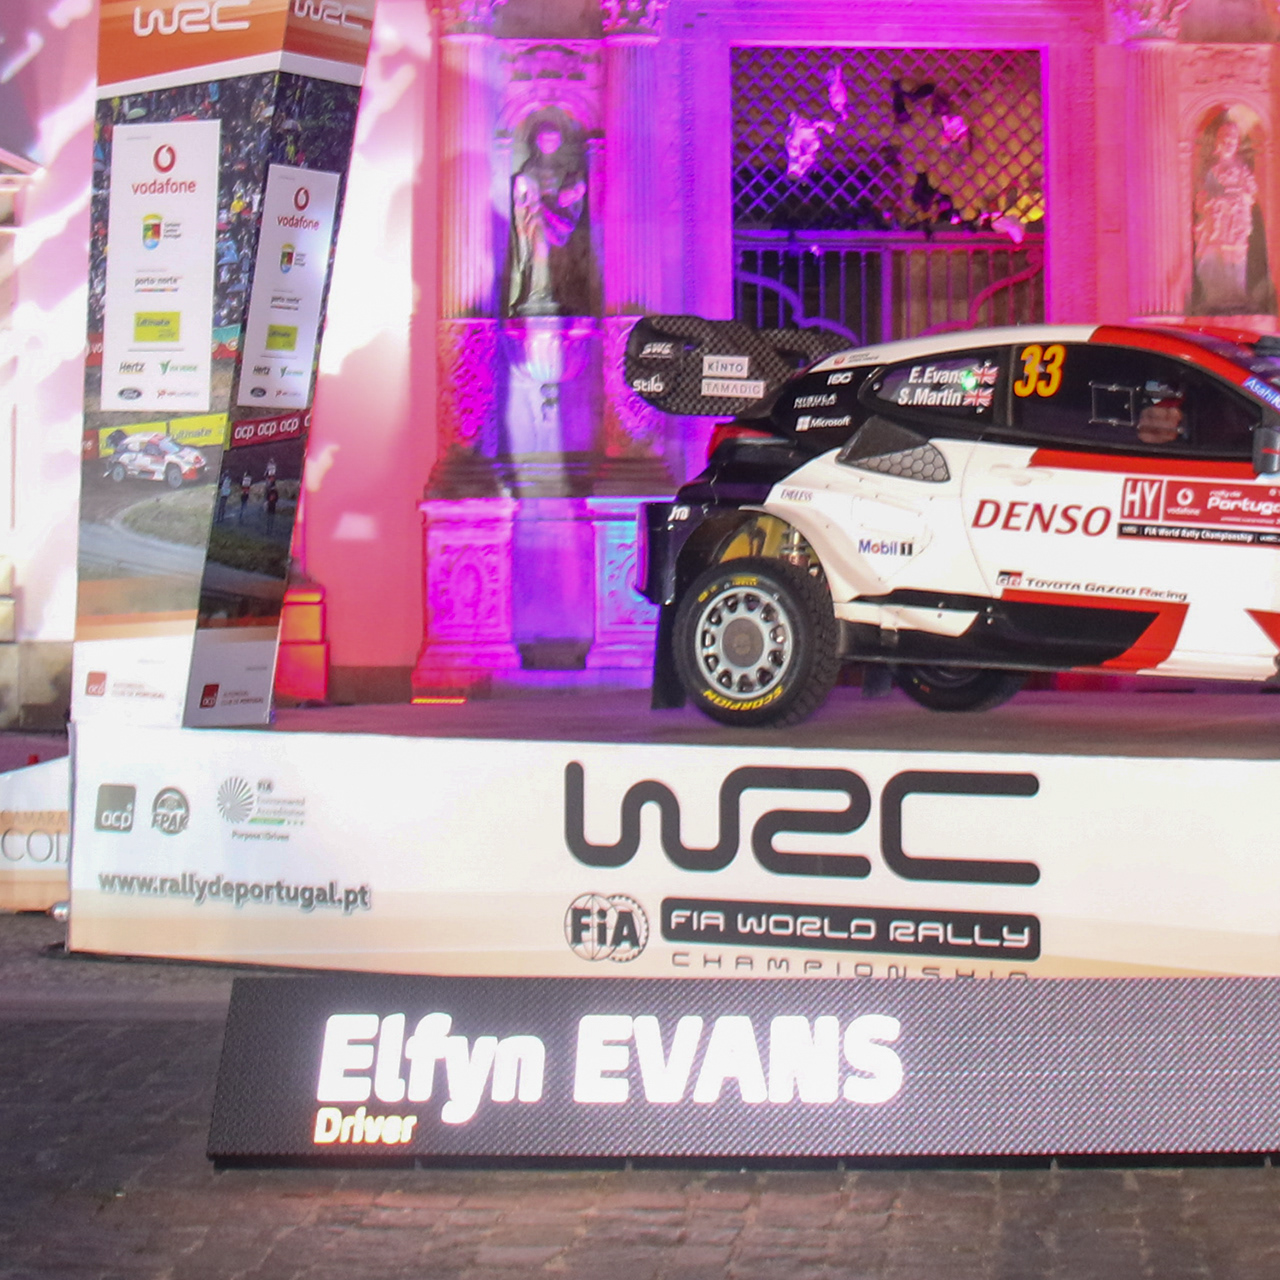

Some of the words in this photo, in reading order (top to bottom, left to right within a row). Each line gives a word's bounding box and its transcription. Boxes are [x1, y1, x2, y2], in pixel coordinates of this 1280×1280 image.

[131, 178, 197, 195] vodafone
[277, 215, 320, 231] vodafone
[908, 366, 966, 384] E.Evans
[1013, 344, 1067, 398] 33
[632, 374, 664, 393] Stilo
[704, 382, 761, 395] TAMADIC
[898, 387, 964, 406] S.Martin
[235, 425, 254, 440] acp
[257, 422, 277, 437] acp
[280, 419, 299, 434] acp
[810, 415, 852, 428] Microsoft
[1123, 480, 1161, 518] HY
[971, 499, 1112, 537] DENSO
[1167, 507, 1201, 516] vodafone
[1158, 528, 1180, 537] World
[1181, 529, 1200, 540] Rally
[1201, 531, 1253, 543] Championship
[858, 539, 898, 556] Mobil
[1025, 578, 1081, 591] TOYOTA
[1084, 583, 1137, 596] GAZOO
[1139, 587, 1188, 602] Racing
[101, 810, 131, 829] acp
[564, 760, 1041, 887] WRC
[1, 827, 69, 863] COI
[99, 872, 371, 912] www.rallydeportugal.pt
[670, 909, 725, 932] FIA
[737, 912, 877, 941] WORLD
[888, 920, 1030, 948] RALLY
[317, 1012, 546, 1124] Elfyn
[573, 1013, 905, 1104] EVANS
[314, 1106, 418, 1144] Driver
